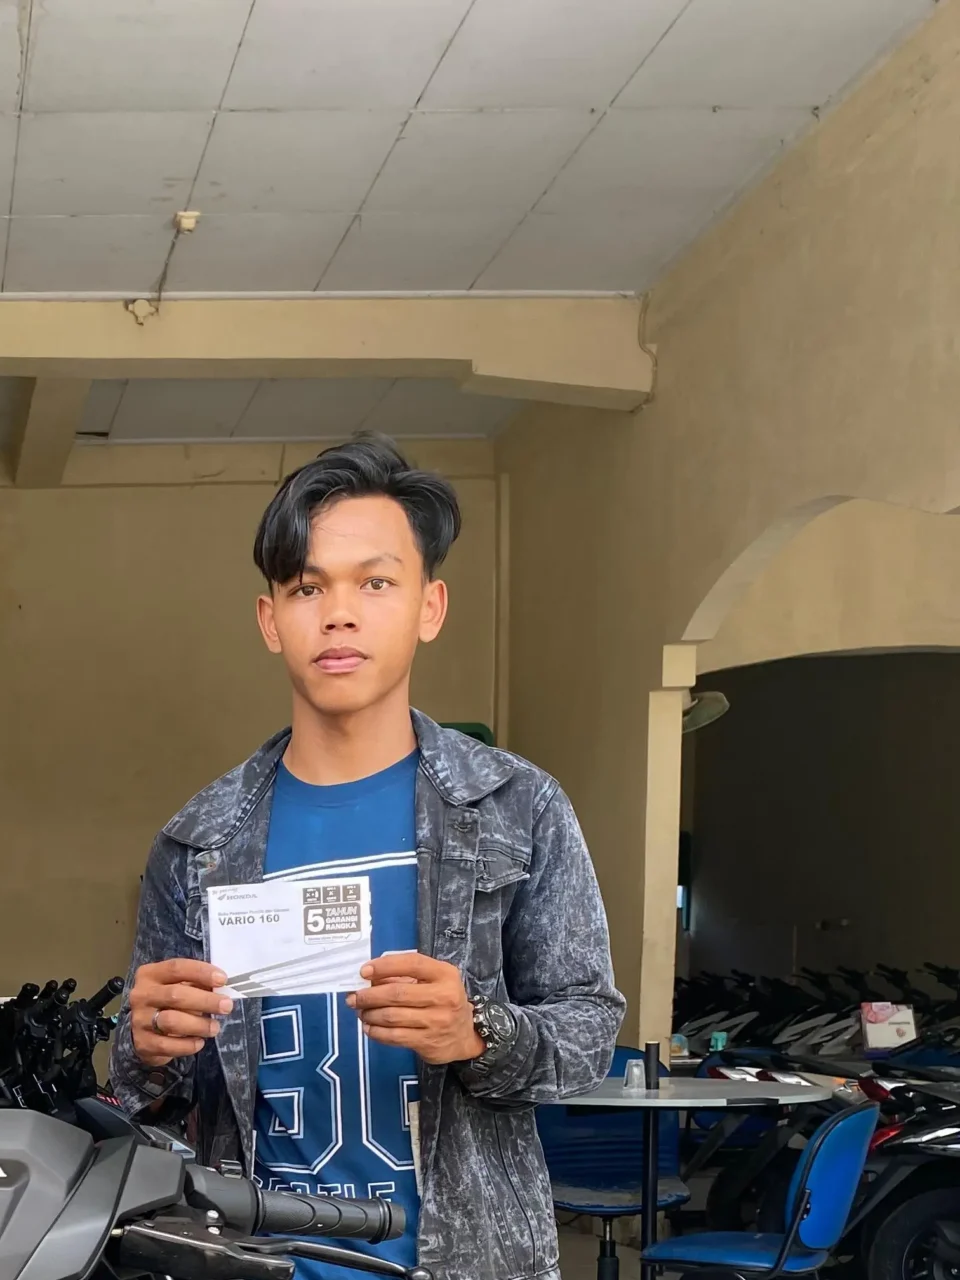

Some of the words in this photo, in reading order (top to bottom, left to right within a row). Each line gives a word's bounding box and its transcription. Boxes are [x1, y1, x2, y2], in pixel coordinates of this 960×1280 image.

[226, 893, 258, 901] HONDA
[325, 906, 358, 917] TAHUN
[218, 915, 256, 926] VARIO
[259, 914, 280, 924] 160
[306, 908, 325, 933] 5
[325, 915, 358, 924] GARANSI
[325, 922, 357, 931] RANGKA
